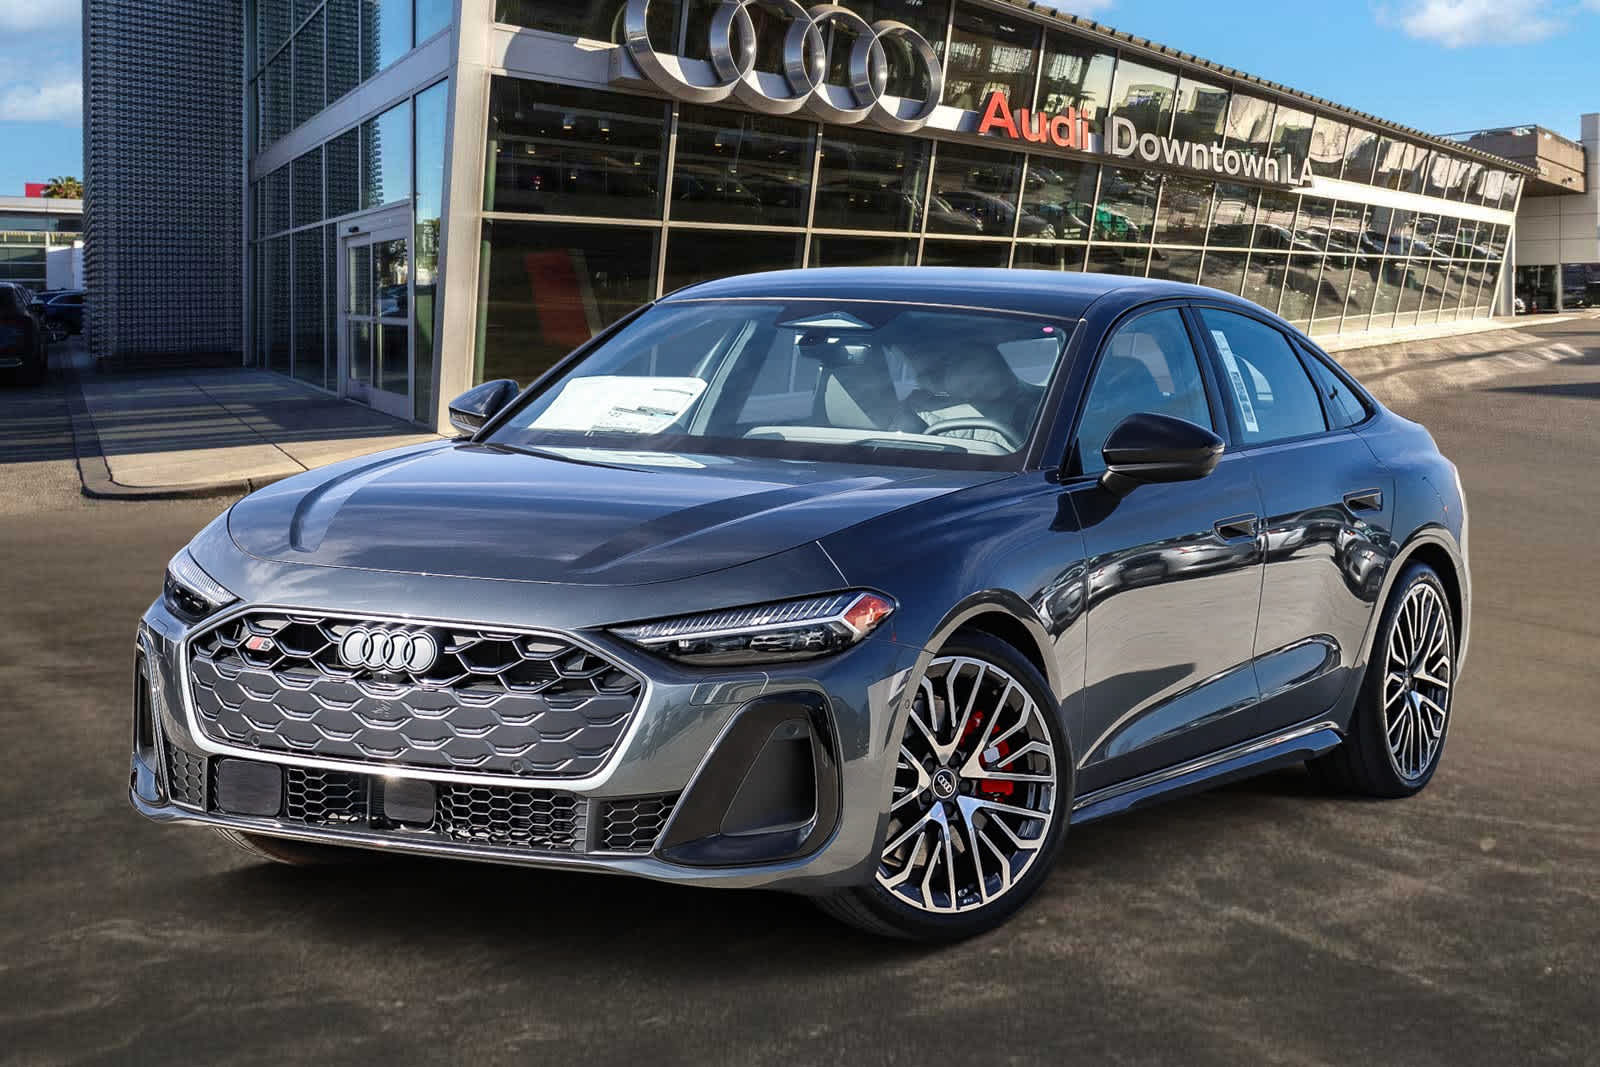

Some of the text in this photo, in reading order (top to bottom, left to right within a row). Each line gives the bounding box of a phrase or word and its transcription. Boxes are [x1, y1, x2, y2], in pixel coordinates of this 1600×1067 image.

[977, 91, 1314, 187] Audi Downtown LA
